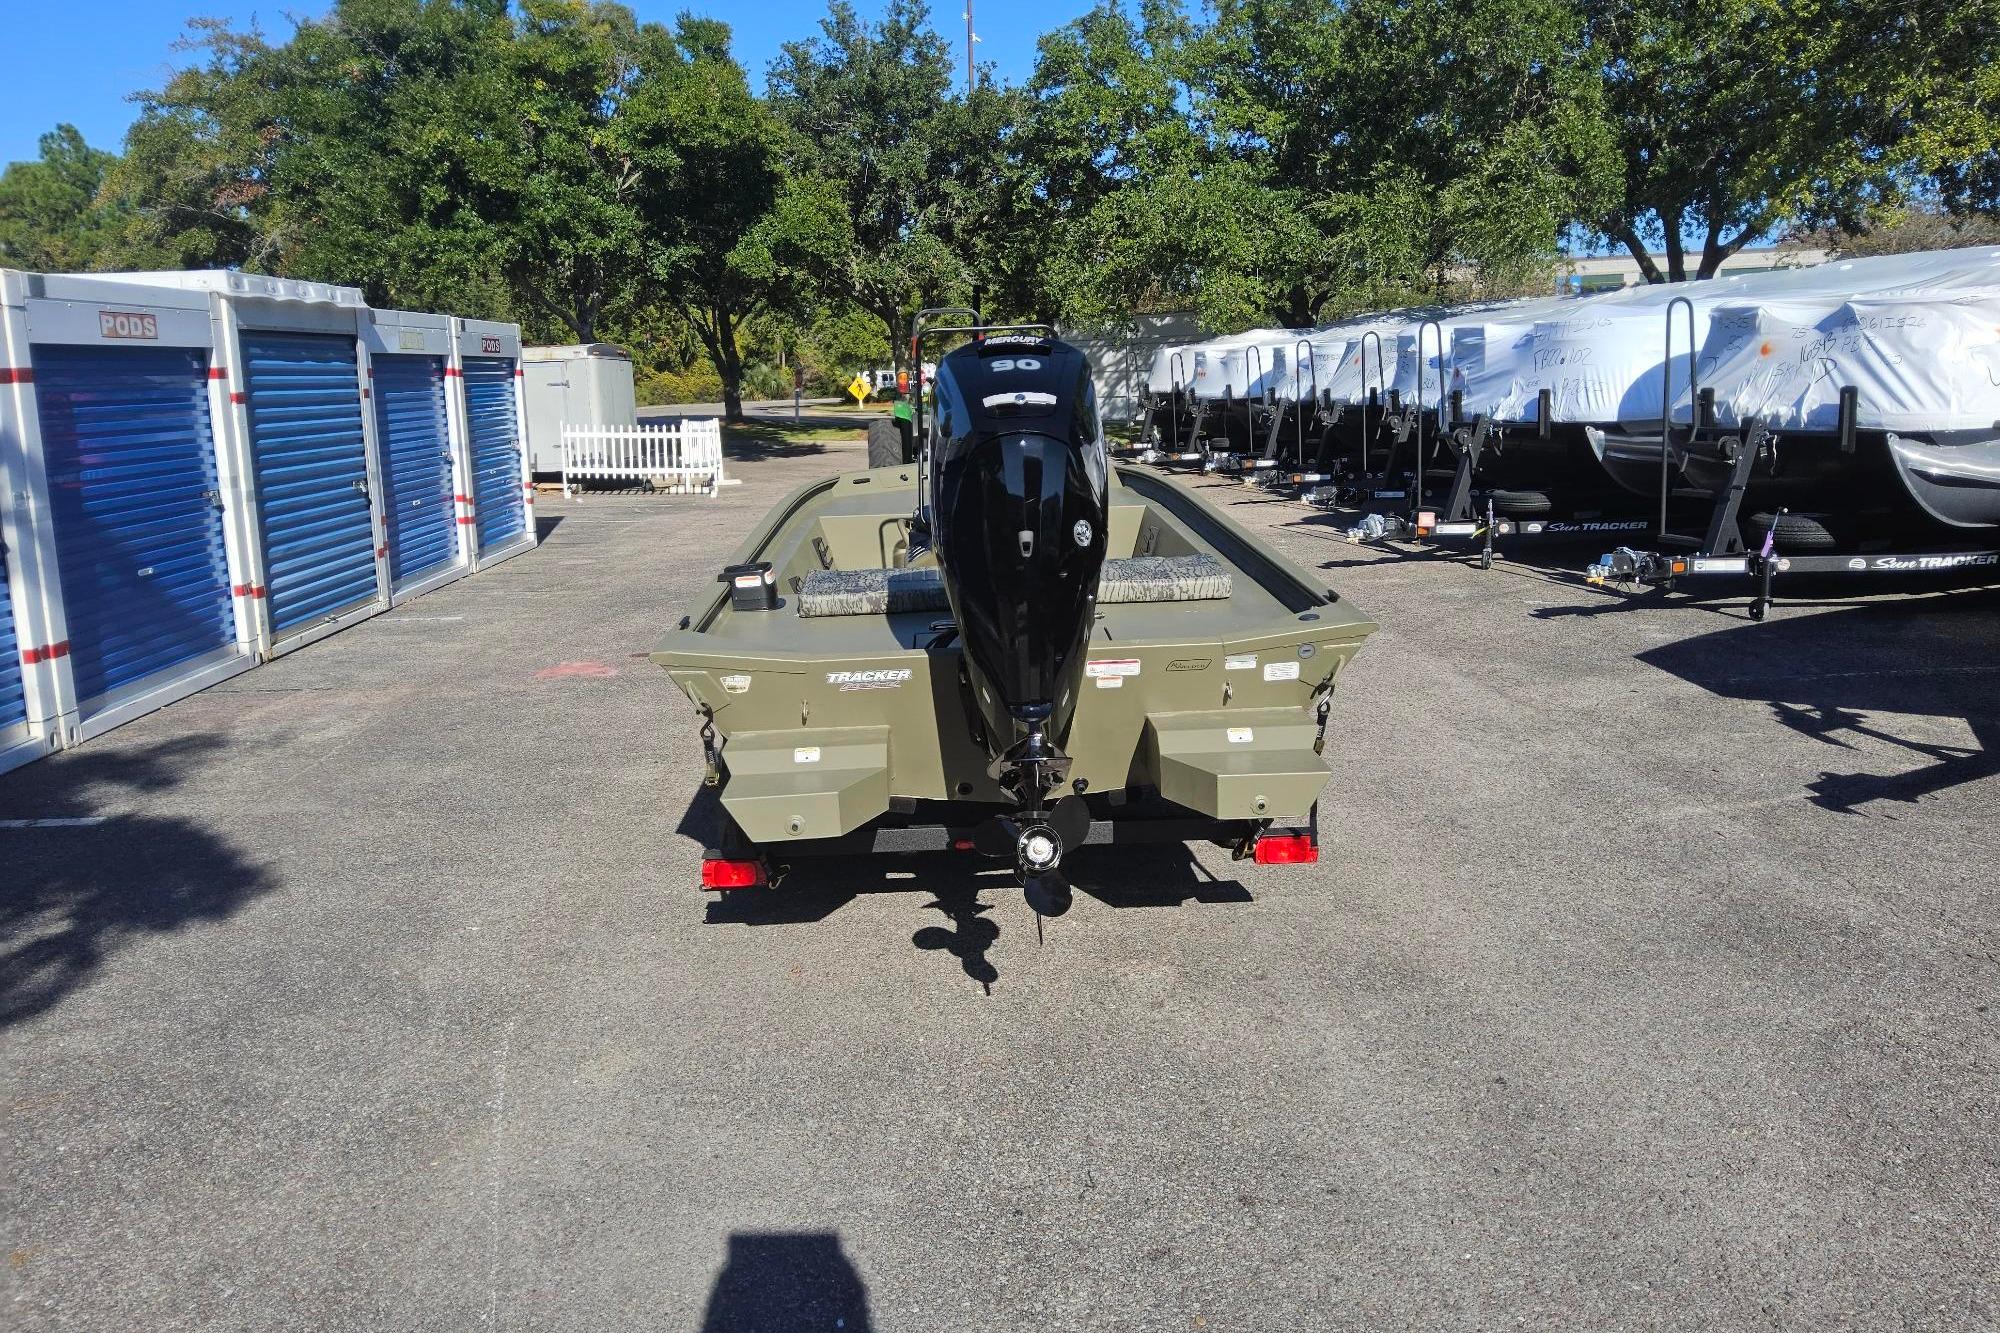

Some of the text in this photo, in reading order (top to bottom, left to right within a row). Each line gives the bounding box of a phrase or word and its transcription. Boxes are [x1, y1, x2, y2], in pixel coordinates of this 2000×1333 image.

[100, 314, 156, 337] PODS
[482, 338, 500, 352] PODS
[984, 335, 1045, 346] MERCURY
[990, 358, 1042, 372] 90
[1545, 521, 1649, 532] Sun TRACKER
[1870, 554, 1999, 570] Sun TRACKER
[826, 669, 913, 684] TRACKER
